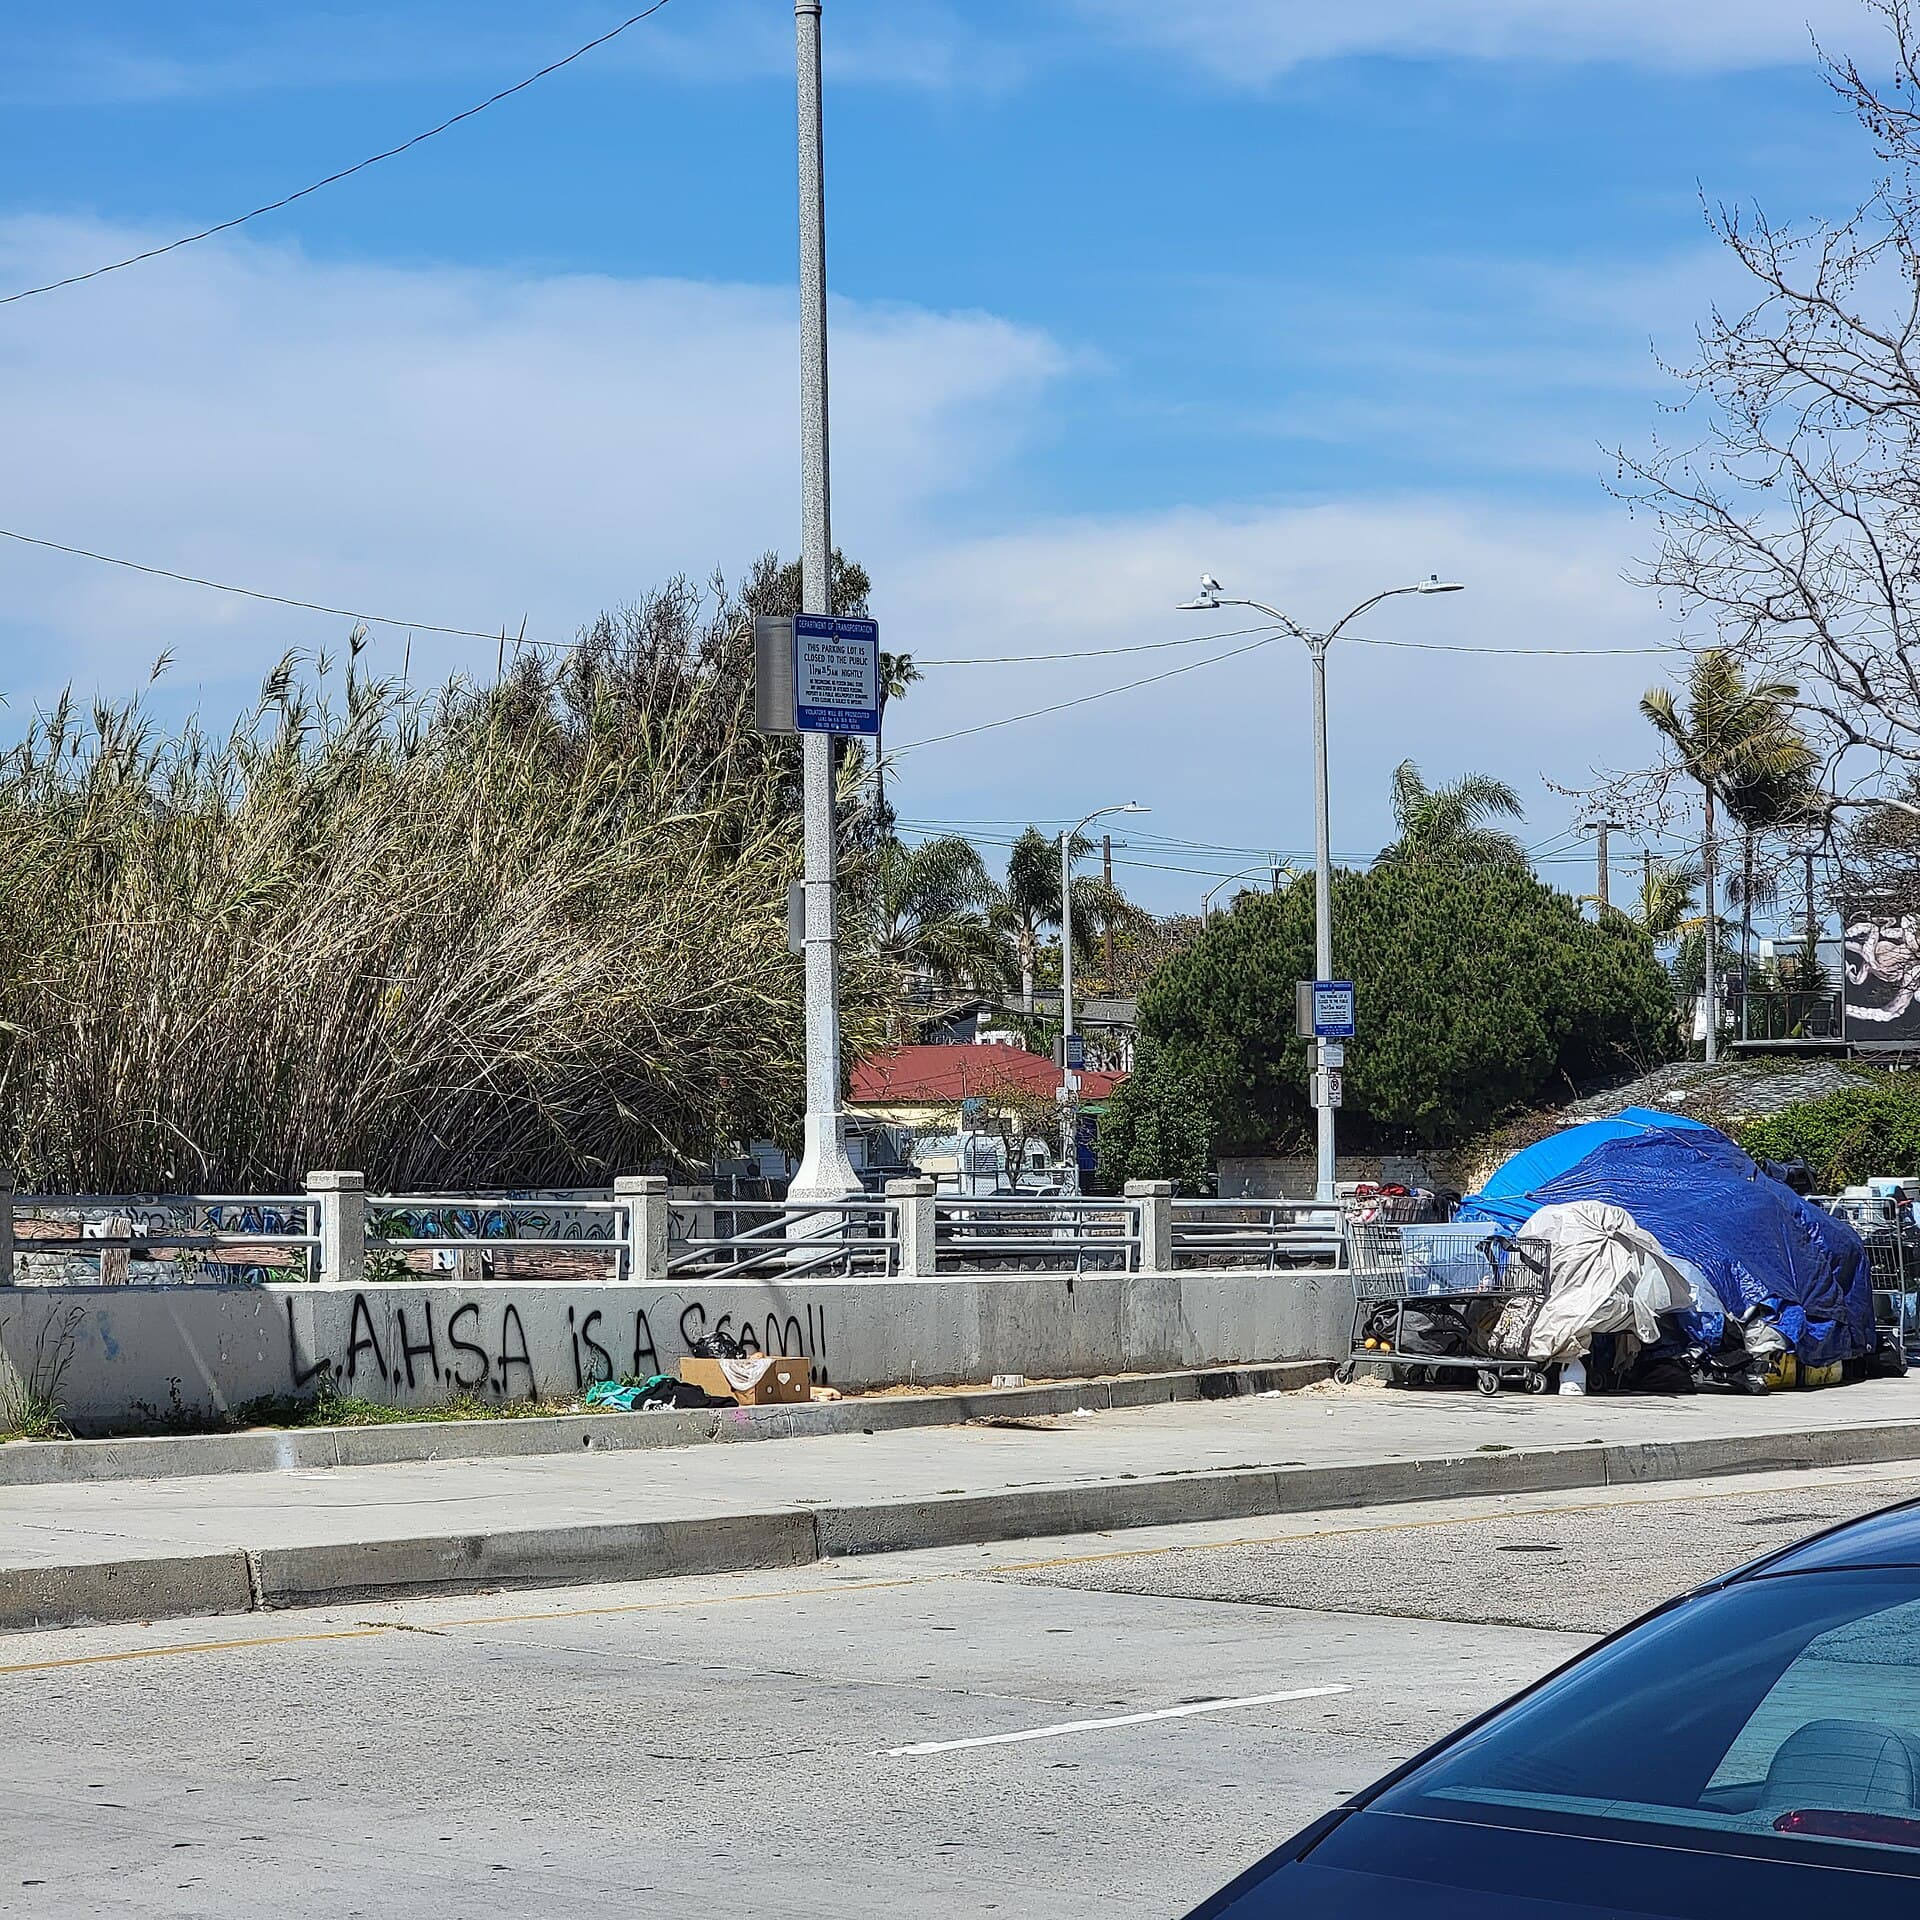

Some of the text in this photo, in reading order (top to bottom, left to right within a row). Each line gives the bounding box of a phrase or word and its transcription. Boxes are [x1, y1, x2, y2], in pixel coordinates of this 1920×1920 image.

[798, 619, 873, 634] DEPARTMENT OF TRANSPORTATION
[807, 643, 865, 656] THIS PARKING LOT IS
[804, 653, 868, 666] CLOSED TO THE PUBLIC
[841, 668, 864, 679] NIGHTLY
